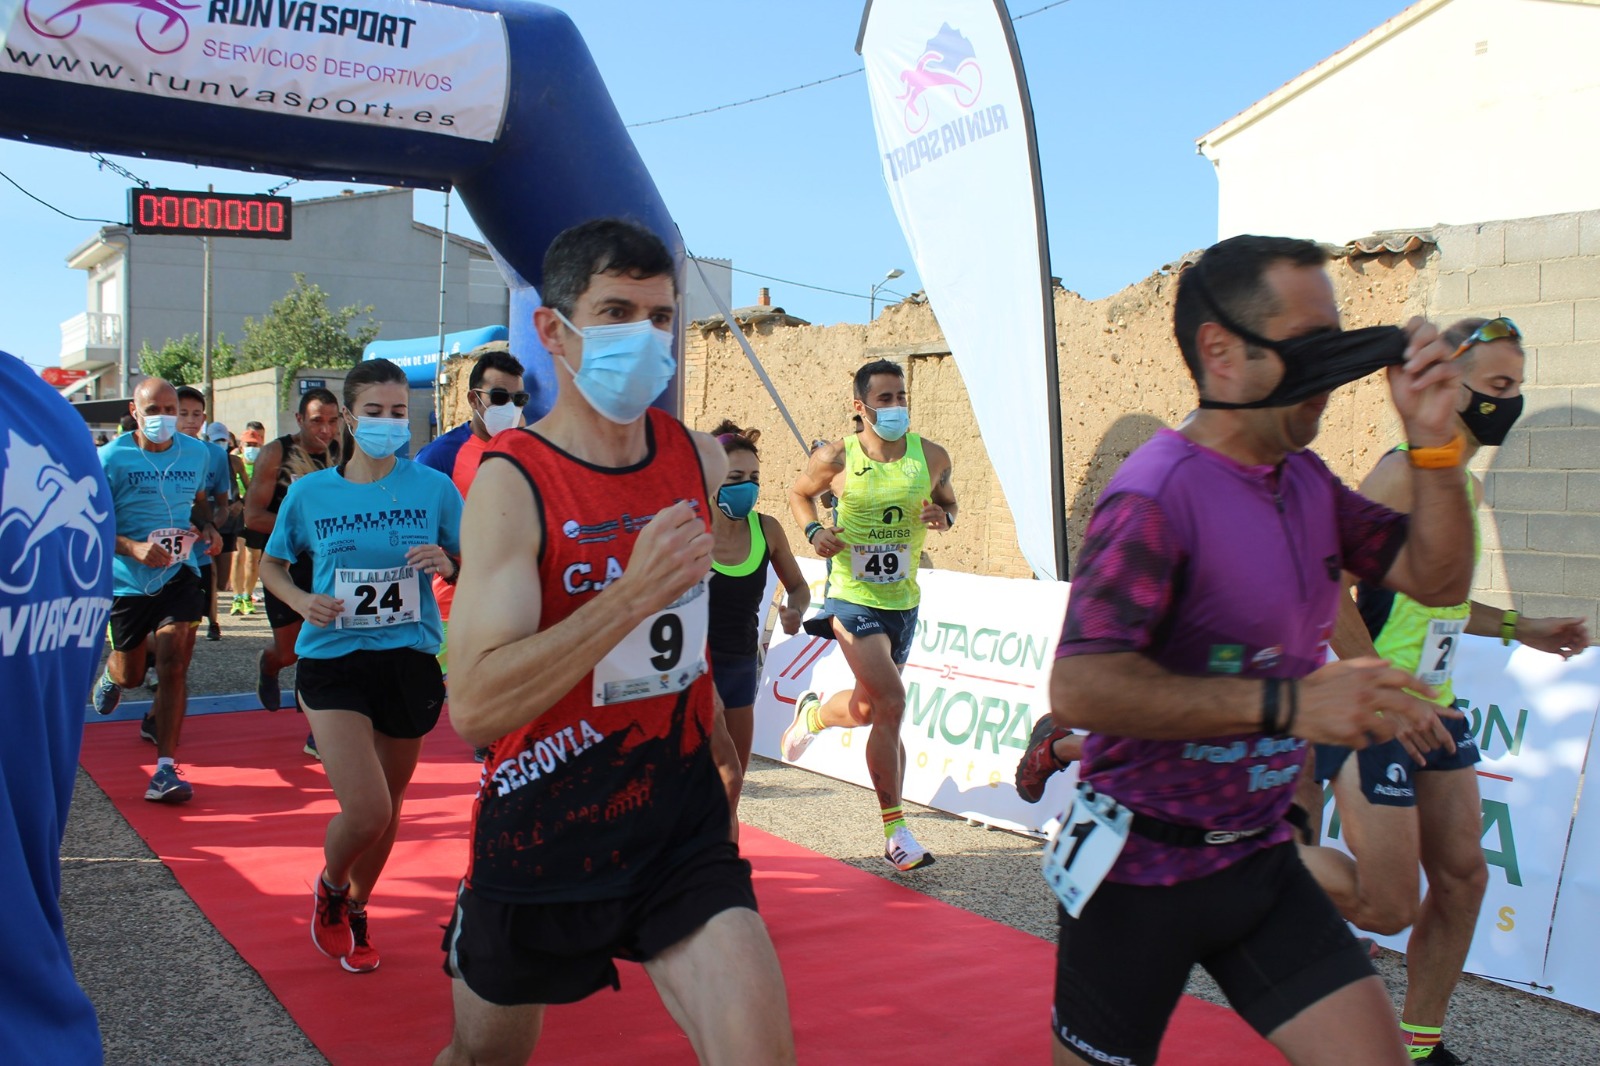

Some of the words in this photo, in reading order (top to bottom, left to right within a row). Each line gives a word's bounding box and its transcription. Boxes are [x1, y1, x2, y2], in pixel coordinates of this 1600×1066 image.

[202, 39, 318, 72] SERVICIOS
[324, 58, 452, 92] DEPORTIVOS
[6, 47, 455, 126] www.runvasport.es
[413, 355, 422, 366] DE
[424, 351, 450, 365] ZAMRA
[314, 509, 428, 540] VILLALAZAN
[868, 528, 911, 540] Adarsa
[161, 536, 184, 555] 35
[327, 545, 357, 556] ZAMORA
[340, 566, 414, 584] VILLALAZAN
[865, 552, 899, 576] 49
[354, 581, 403, 616] 24
[649, 612, 684, 672] 9
[1433, 636, 1453, 671] 2
[491, 719, 605, 797] SEGOVIA
